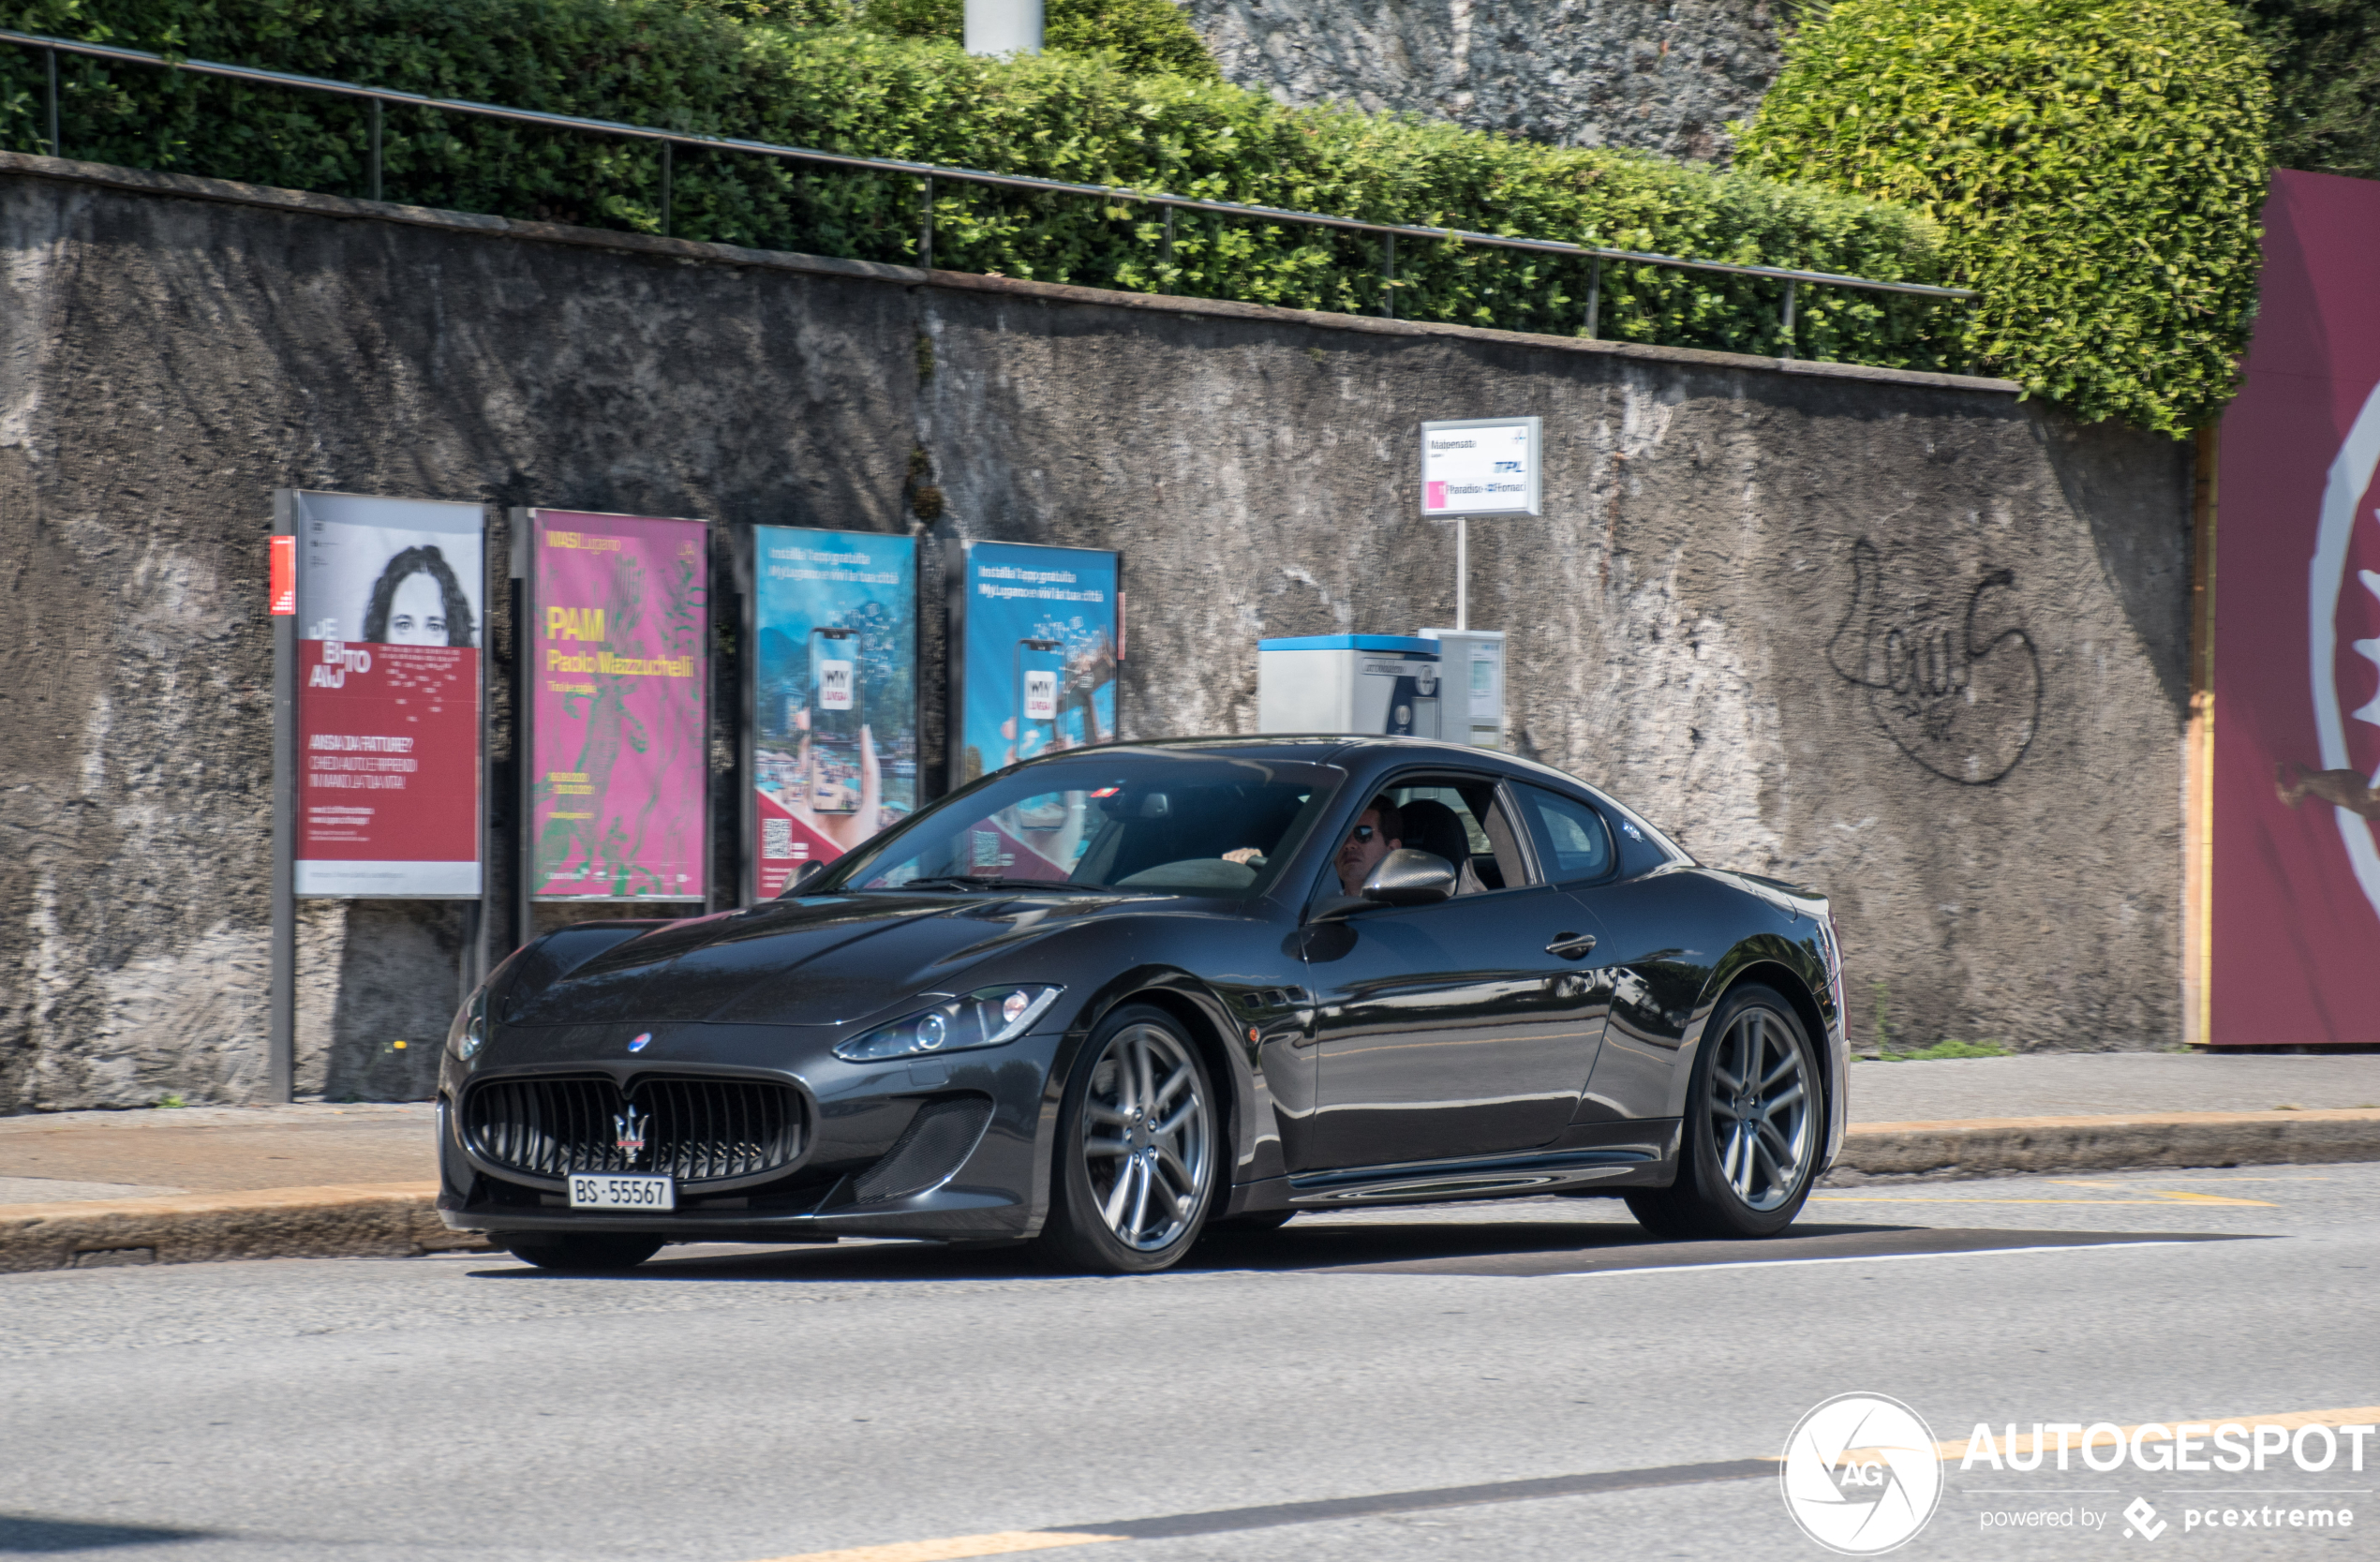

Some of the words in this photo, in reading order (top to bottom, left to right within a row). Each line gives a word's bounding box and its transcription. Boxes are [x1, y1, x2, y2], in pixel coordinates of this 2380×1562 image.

[1493, 460, 1526, 474] TPL
[1447, 483, 1483, 495] Paradiso
[545, 530, 581, 549] MASI
[546, 606, 605, 642] PAM
[546, 648, 597, 674] Paolo
[596, 650, 694, 677] Mazzuchelli
